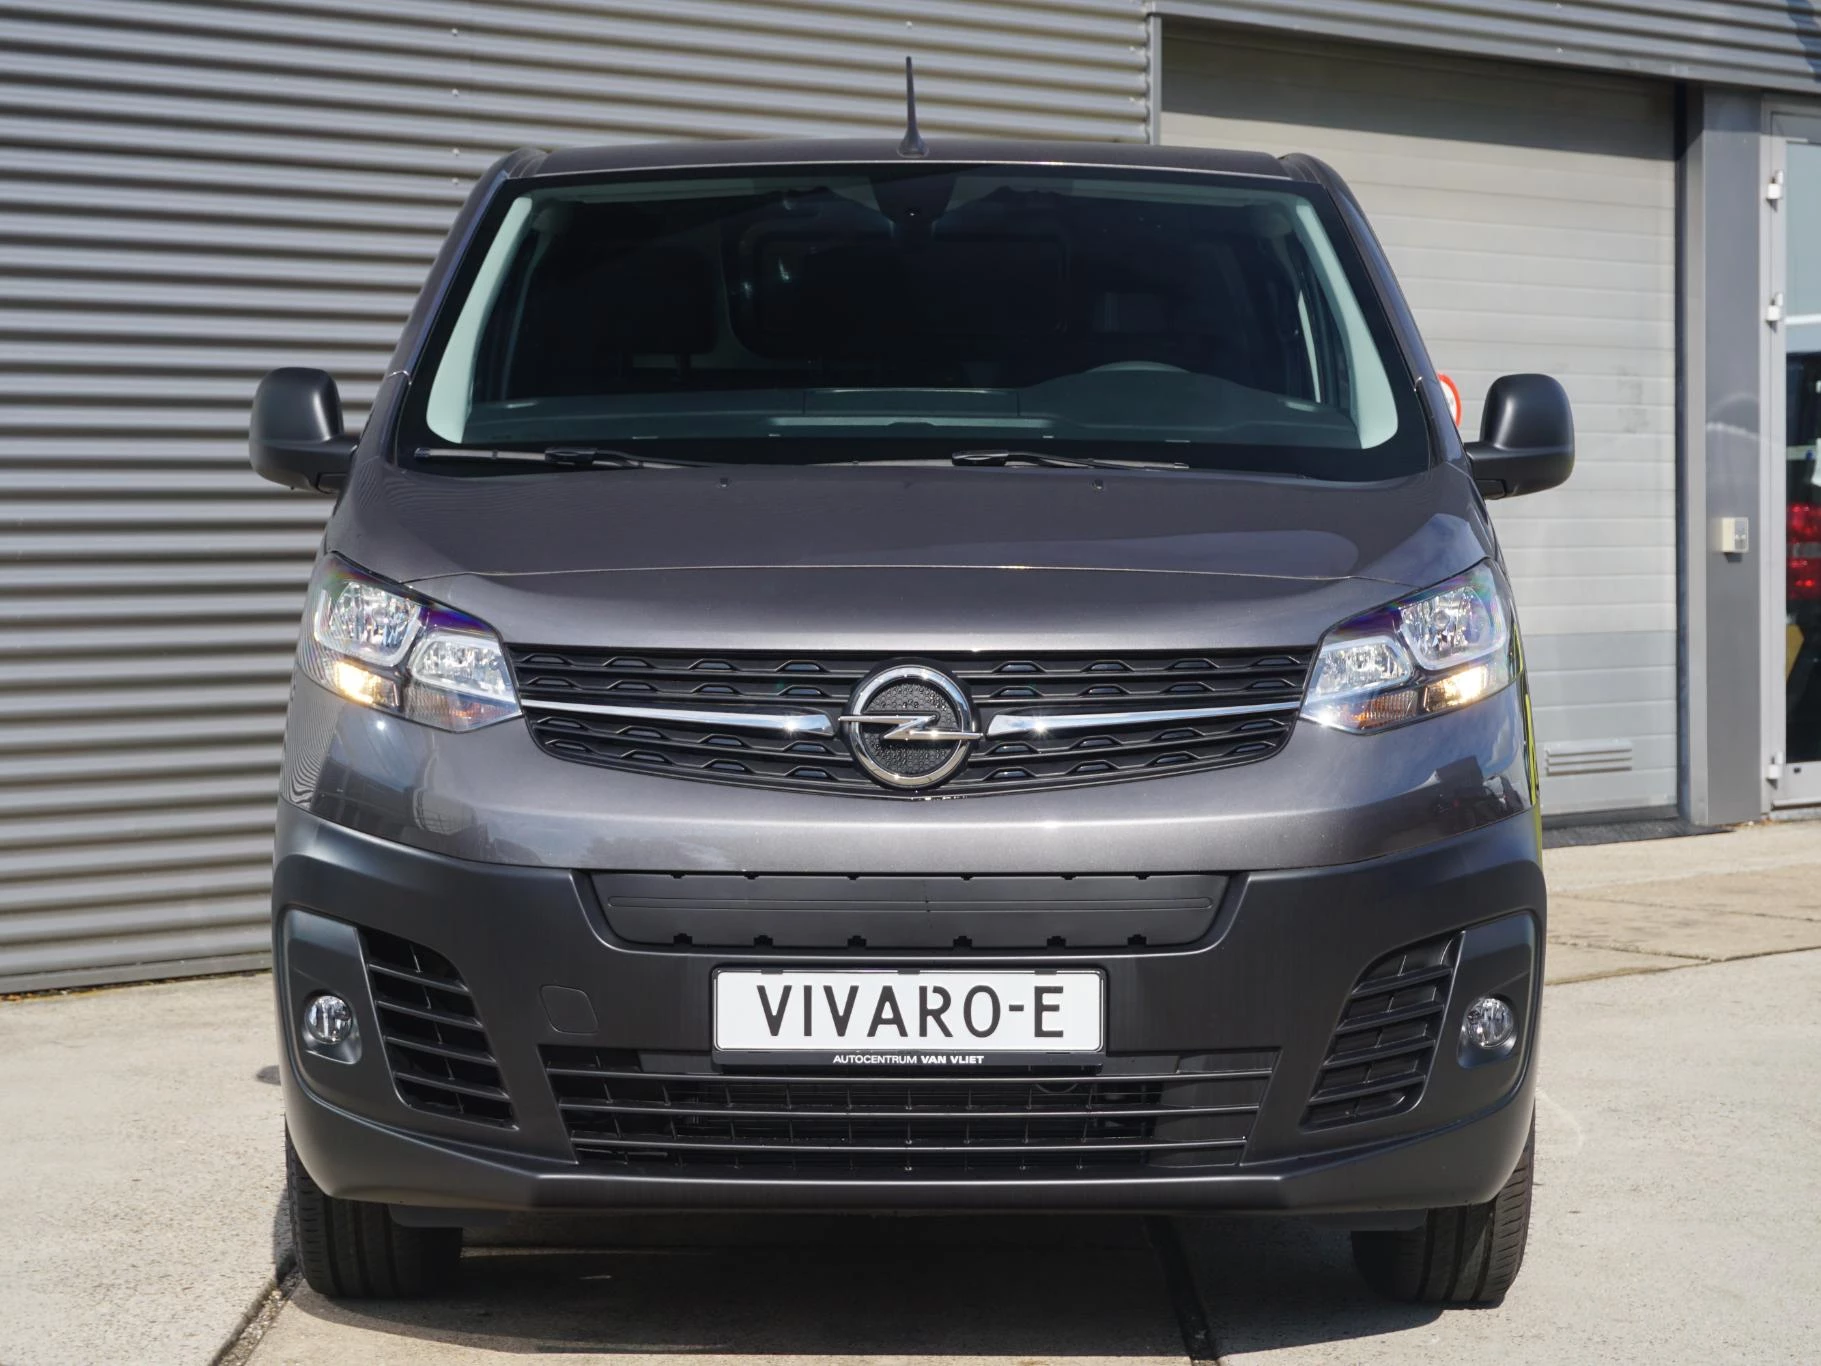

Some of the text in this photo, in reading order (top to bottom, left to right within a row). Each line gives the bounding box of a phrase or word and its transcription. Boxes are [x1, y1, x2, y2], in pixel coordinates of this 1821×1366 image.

[756, 985, 1064, 1038] VIVARO-E
[832, 1054, 985, 1064] AUTOCENTRUM VAN VLIET
